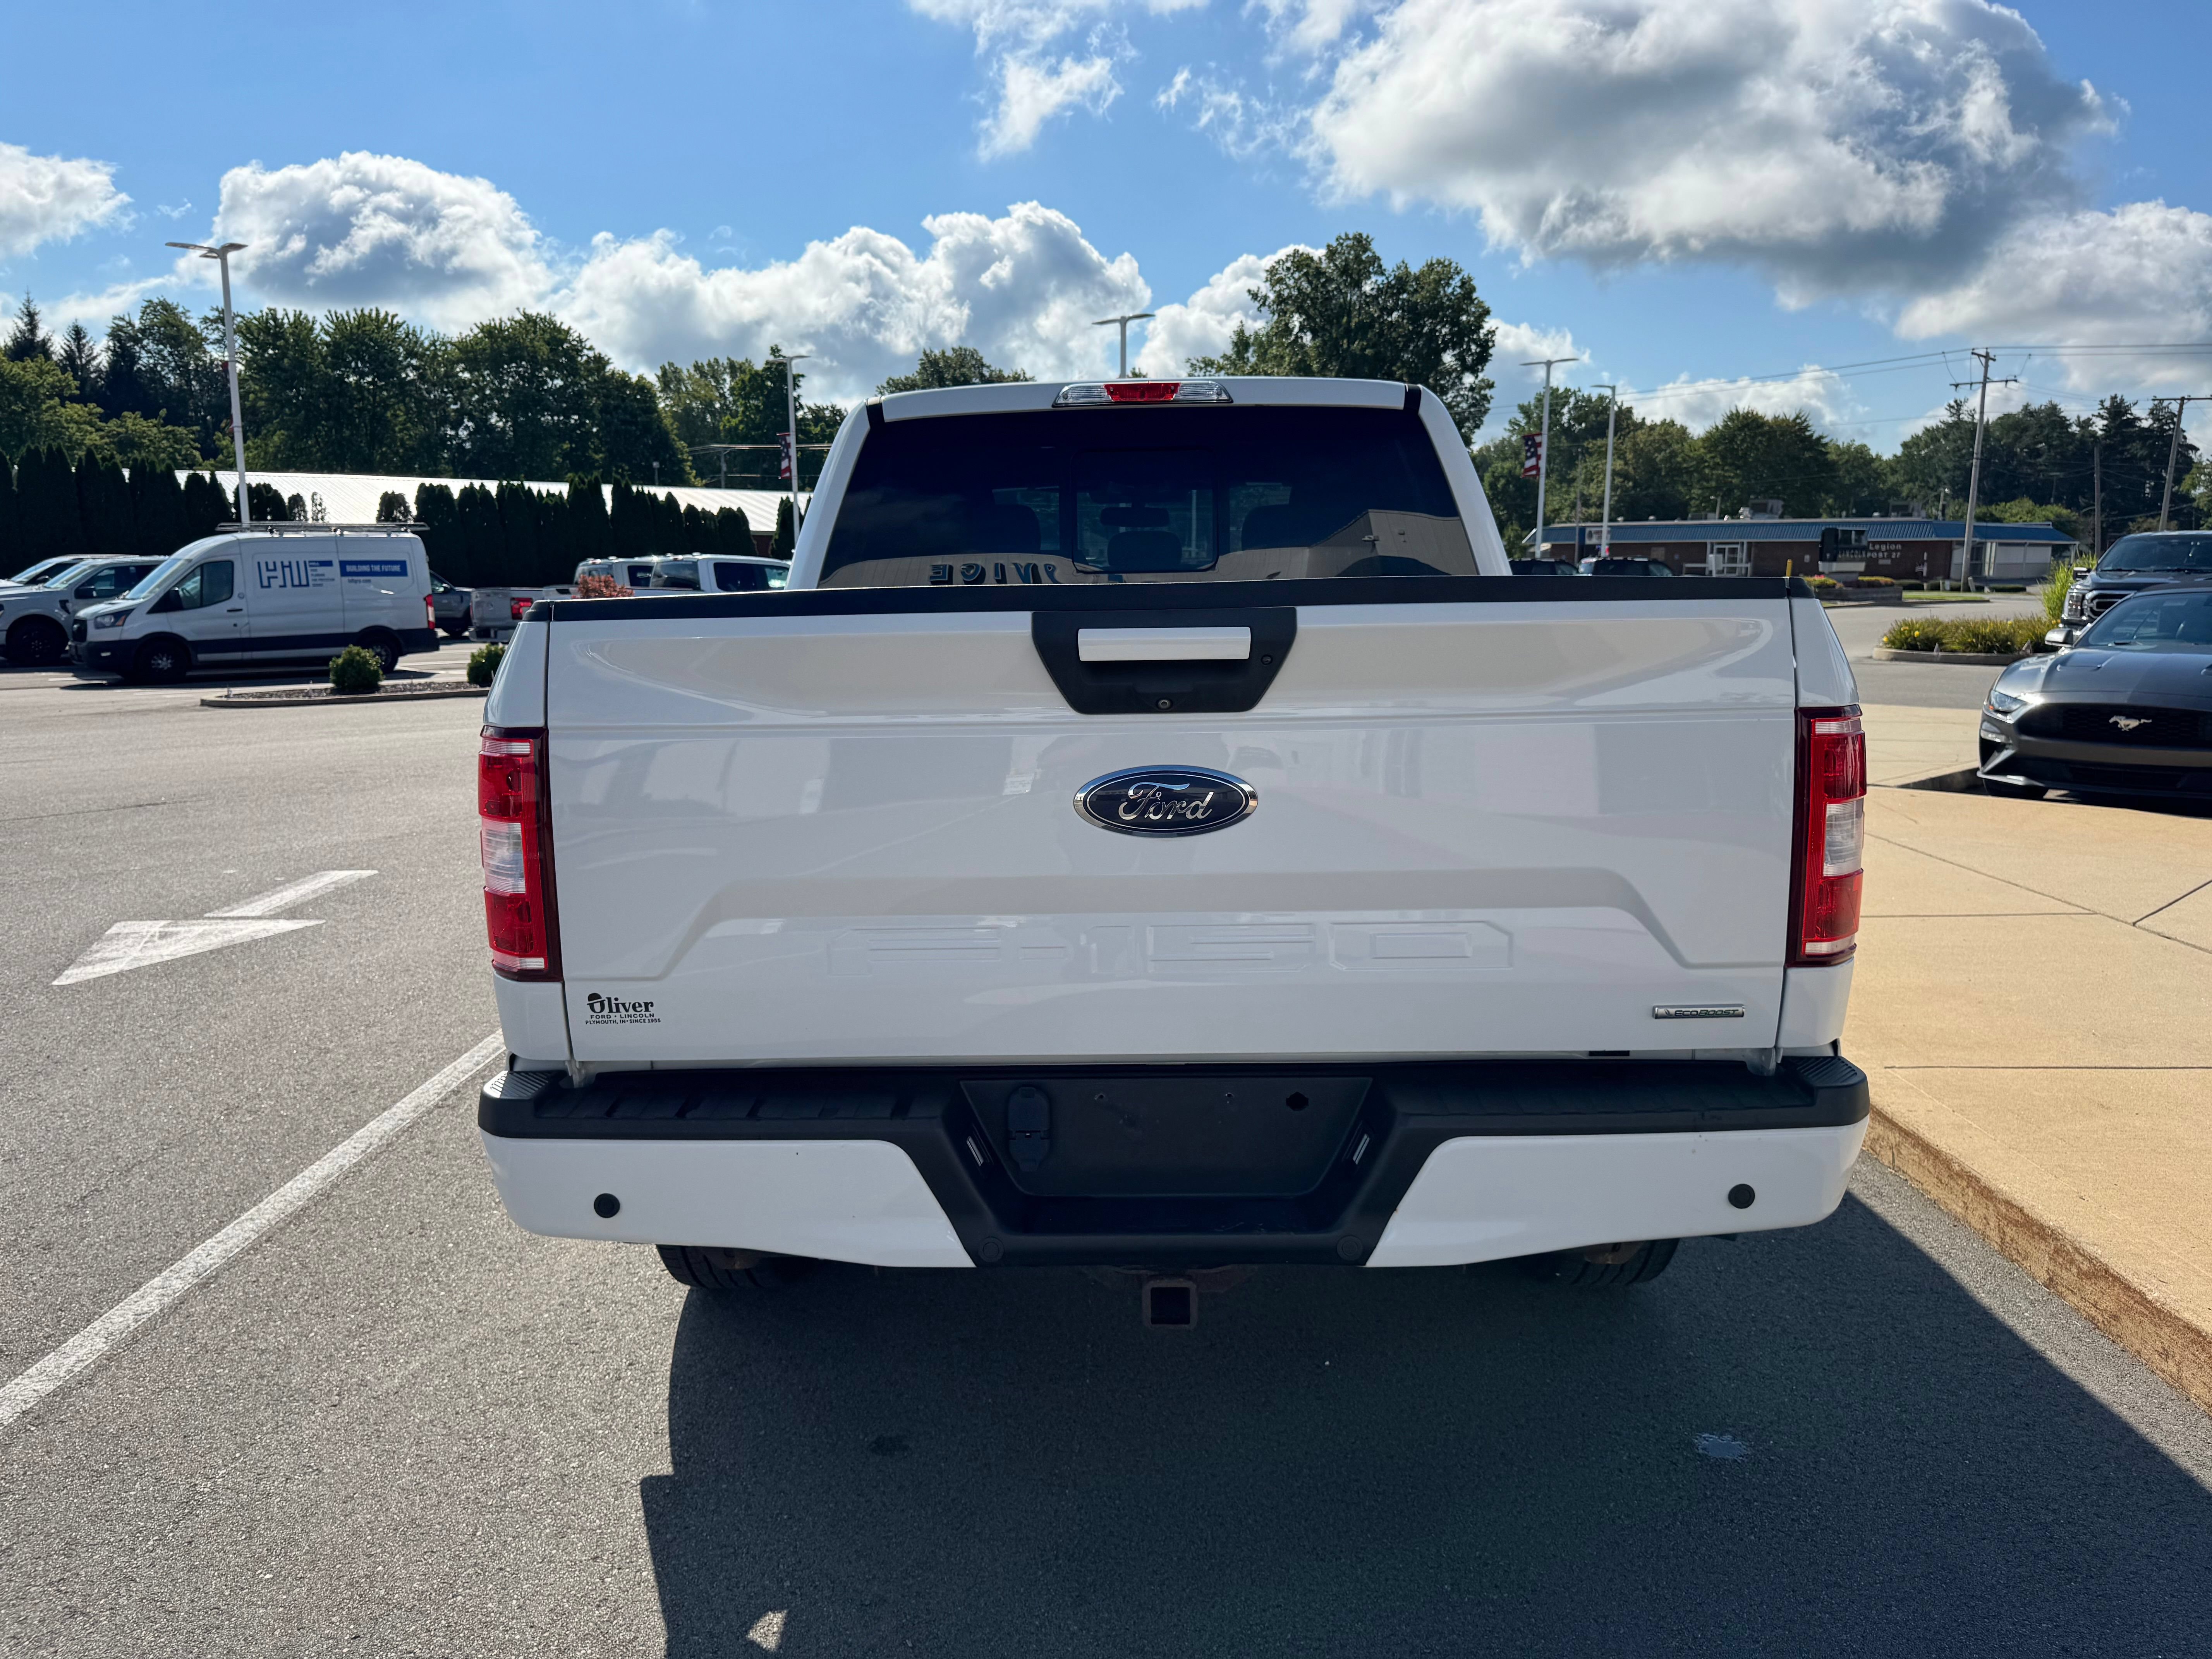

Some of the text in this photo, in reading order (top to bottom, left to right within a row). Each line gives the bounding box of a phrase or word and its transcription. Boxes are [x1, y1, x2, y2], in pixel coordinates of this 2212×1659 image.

[1869, 542, 1901, 551] Legion
[1118, 781, 1214, 820] Ford
[587, 993, 654, 1013] Oliver
